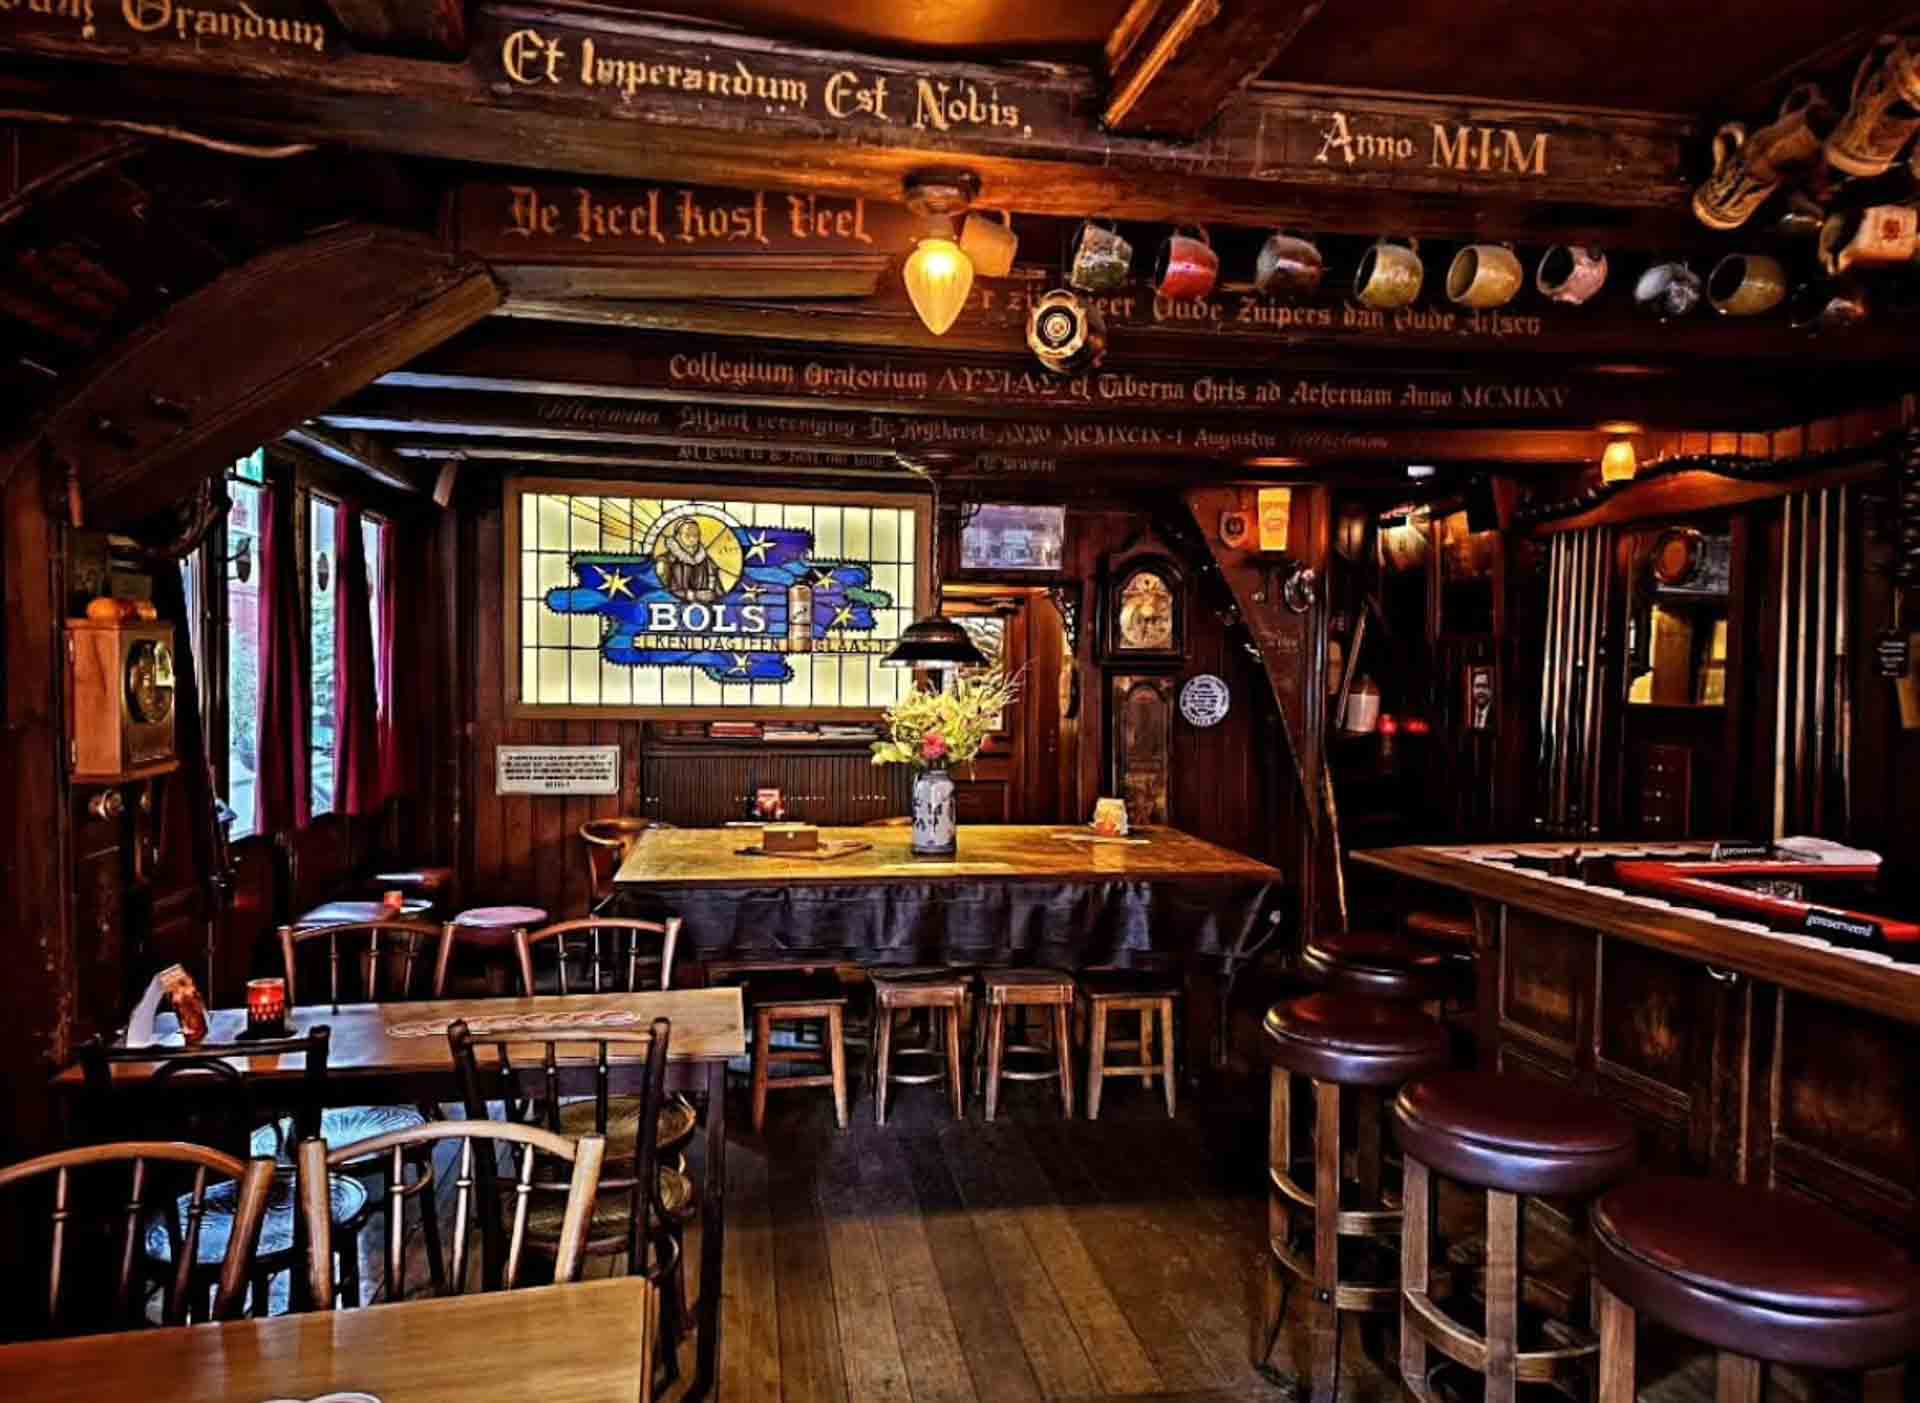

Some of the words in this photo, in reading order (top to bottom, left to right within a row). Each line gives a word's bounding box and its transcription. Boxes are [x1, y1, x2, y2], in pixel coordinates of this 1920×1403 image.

[503, 30, 564, 85] Et
[582, 40, 808, 109] Imperandum
[824, 71, 890, 121] Est
[1313, 111, 1414, 165] Anno
[669, 352, 794, 387] Collegium
[804, 361, 927, 391] Oratorium
[648, 603, 766, 632] BOLS
